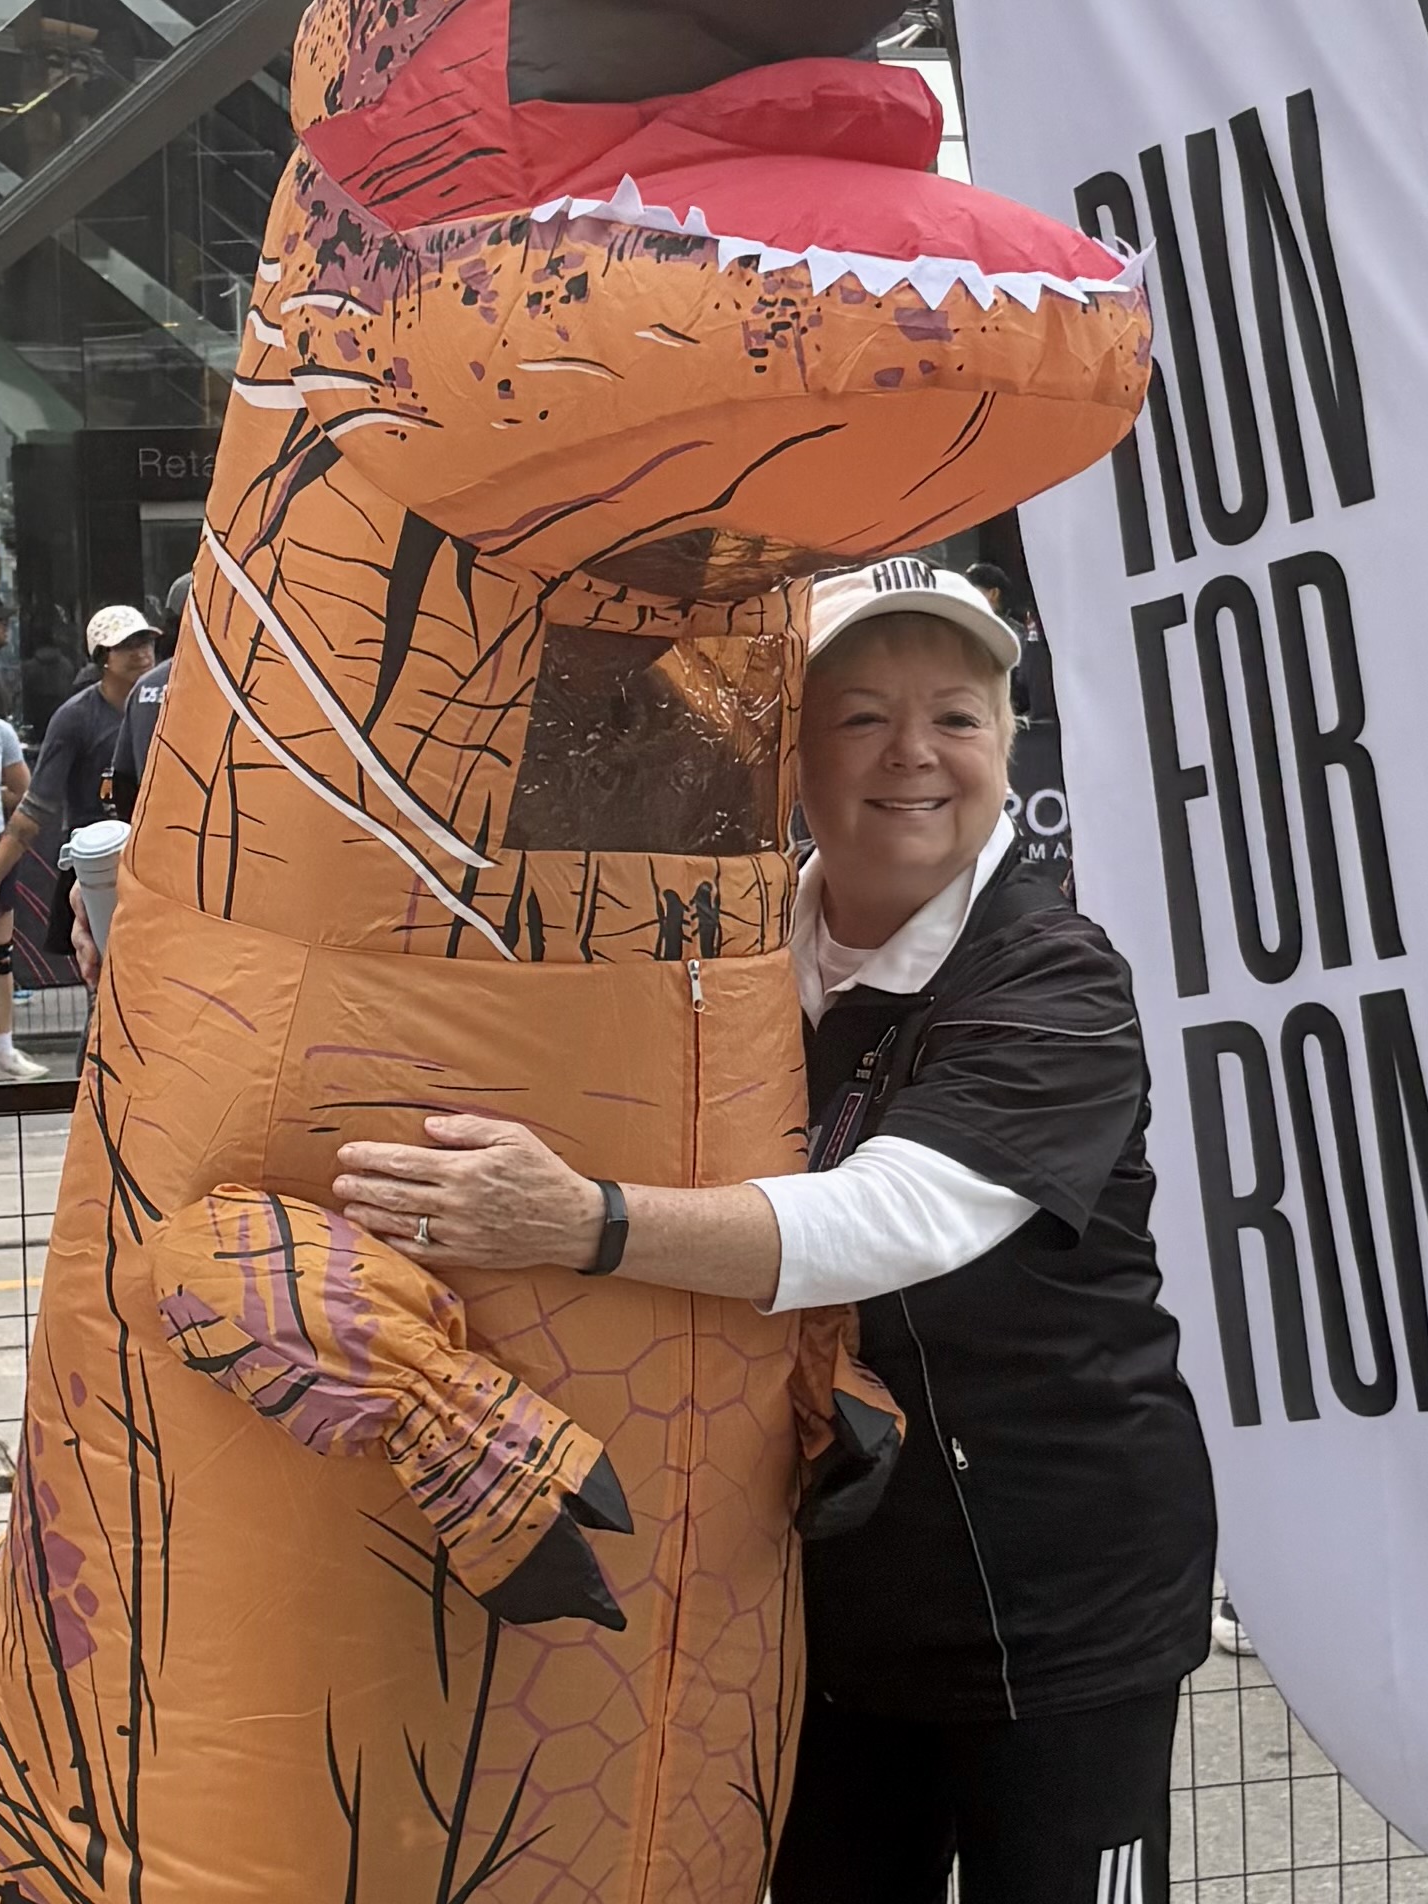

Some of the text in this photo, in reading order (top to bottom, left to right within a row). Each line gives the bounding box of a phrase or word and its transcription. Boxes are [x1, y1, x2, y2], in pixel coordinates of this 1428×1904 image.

[1073, 87, 1375, 576] RUN
[873, 559, 937, 593] ROM
[1130, 549, 1406, 998] FOR
